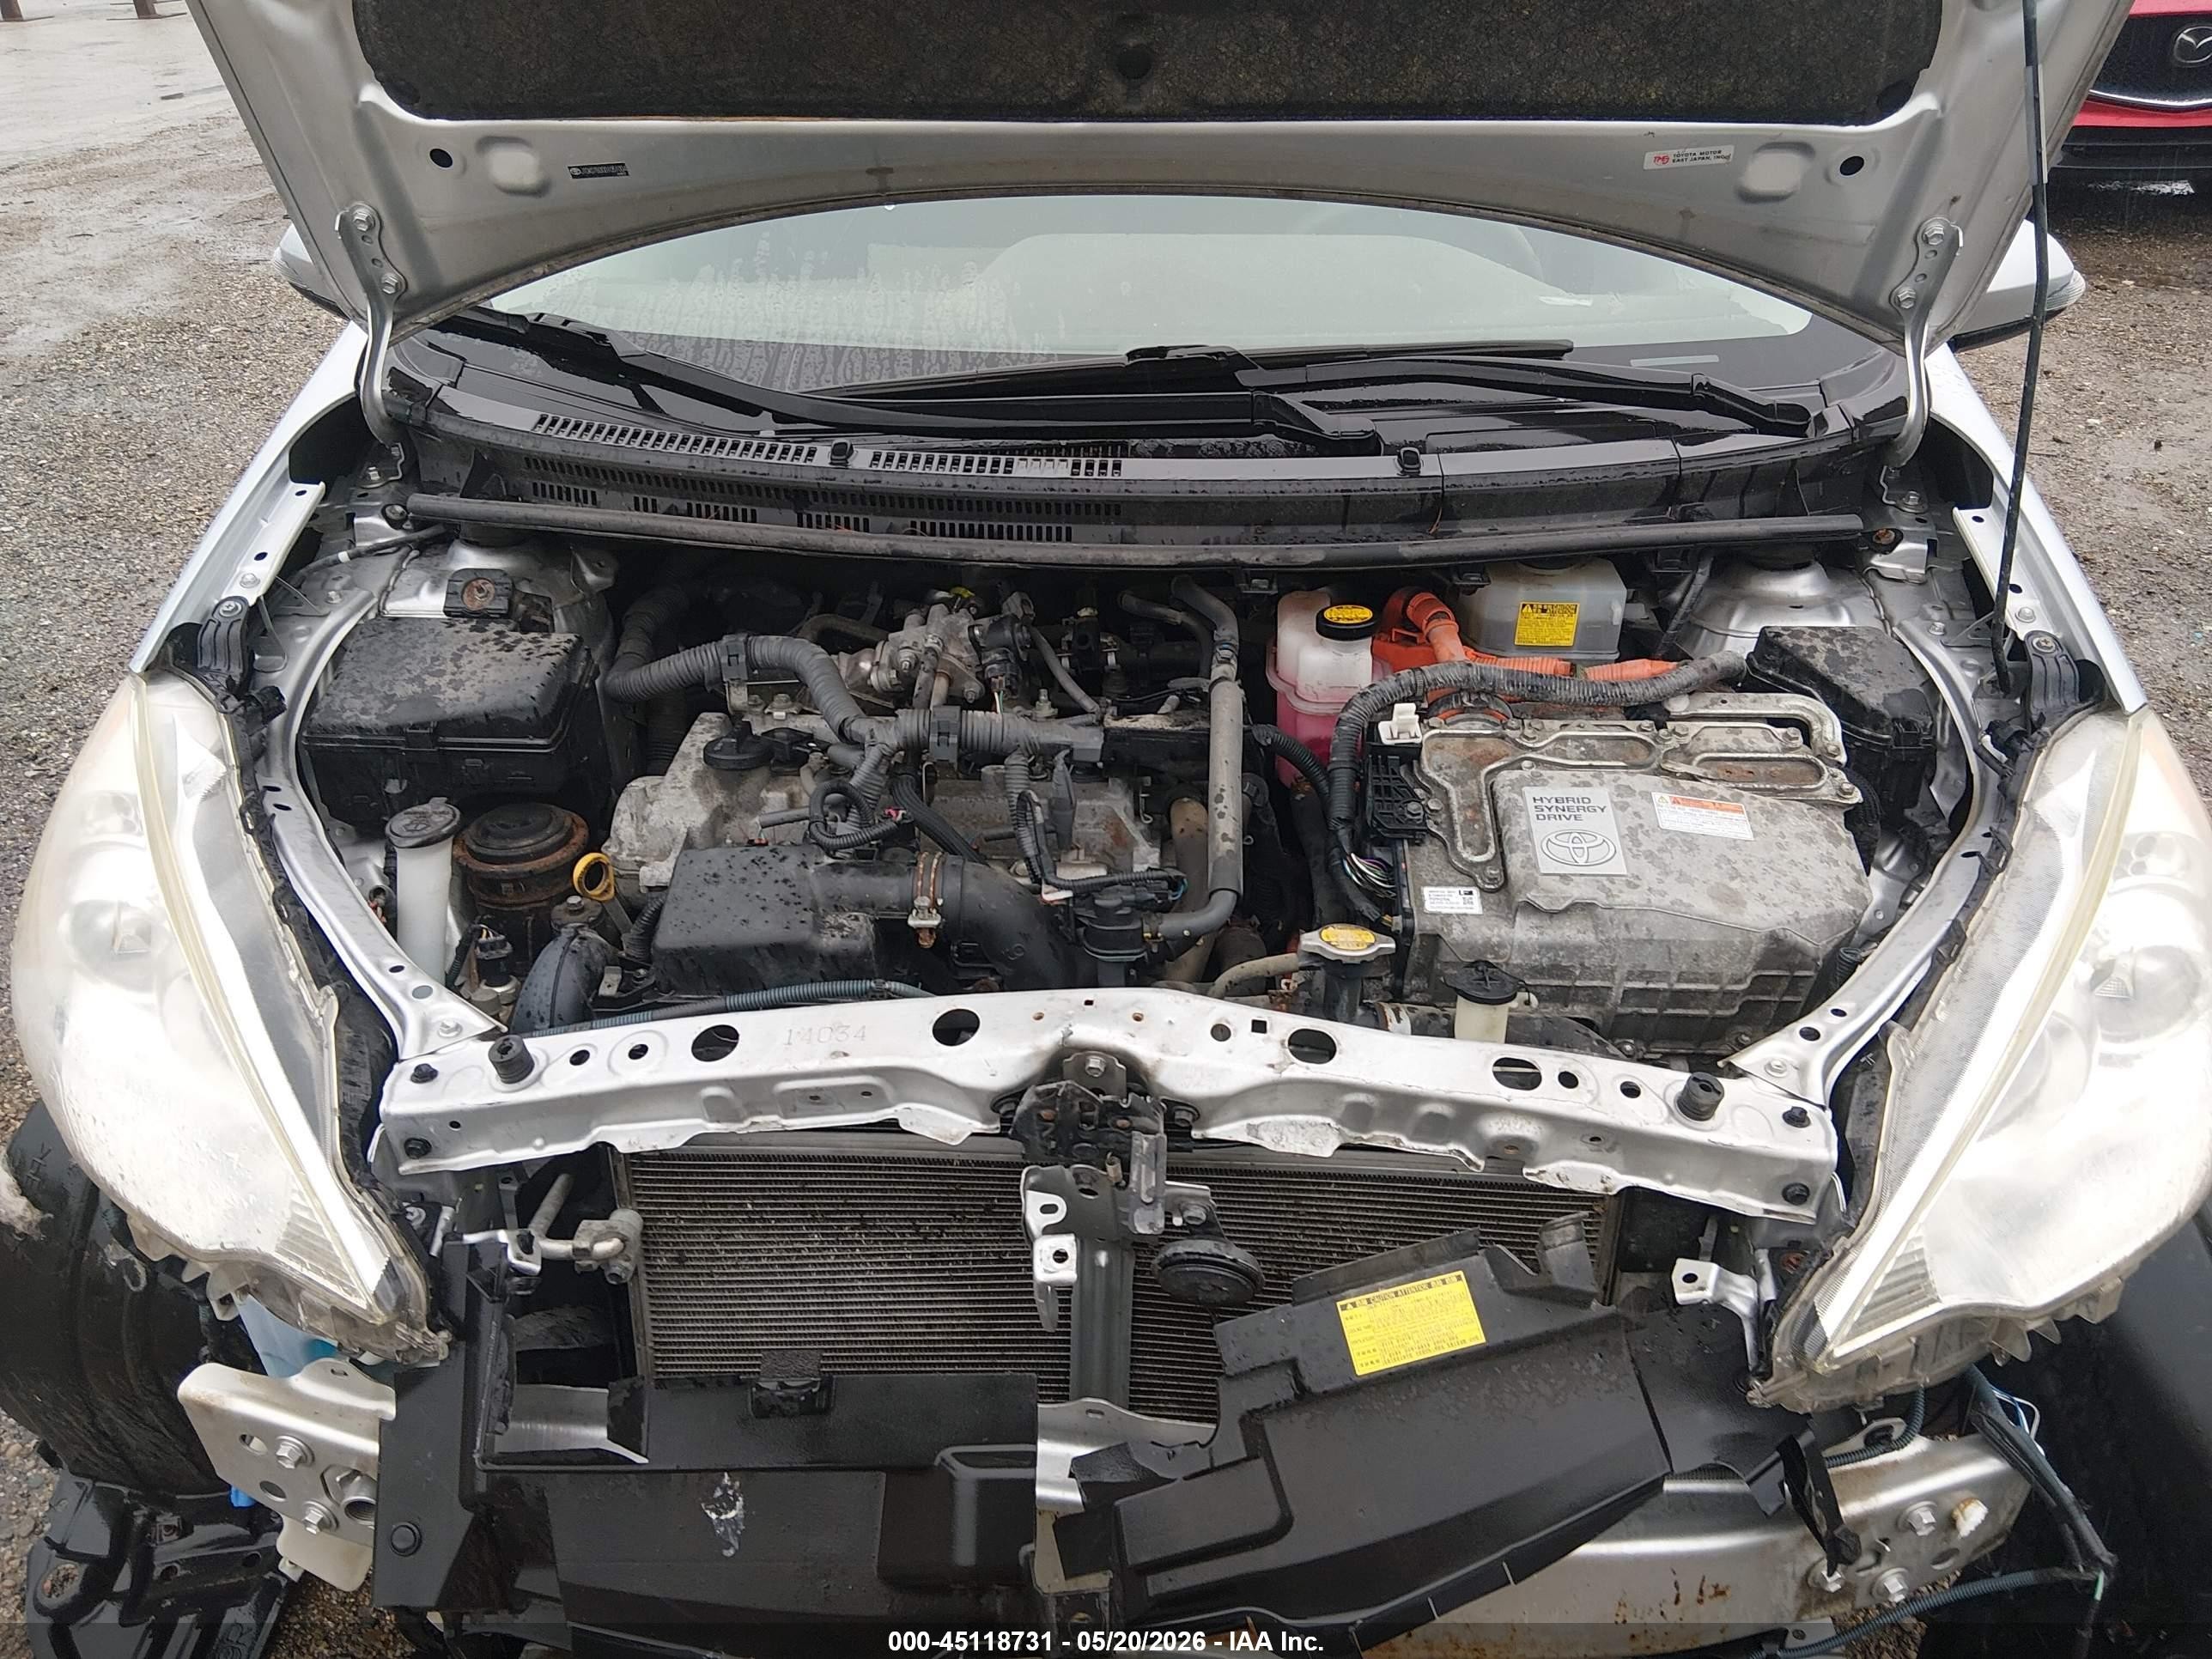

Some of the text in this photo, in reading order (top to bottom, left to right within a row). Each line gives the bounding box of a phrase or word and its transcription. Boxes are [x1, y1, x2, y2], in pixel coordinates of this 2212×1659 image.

[1532, 796, 1592, 805] HYBRID
[1534, 805, 1607, 813] SYNERGY
[1535, 813, 1583, 822] DRIVE
